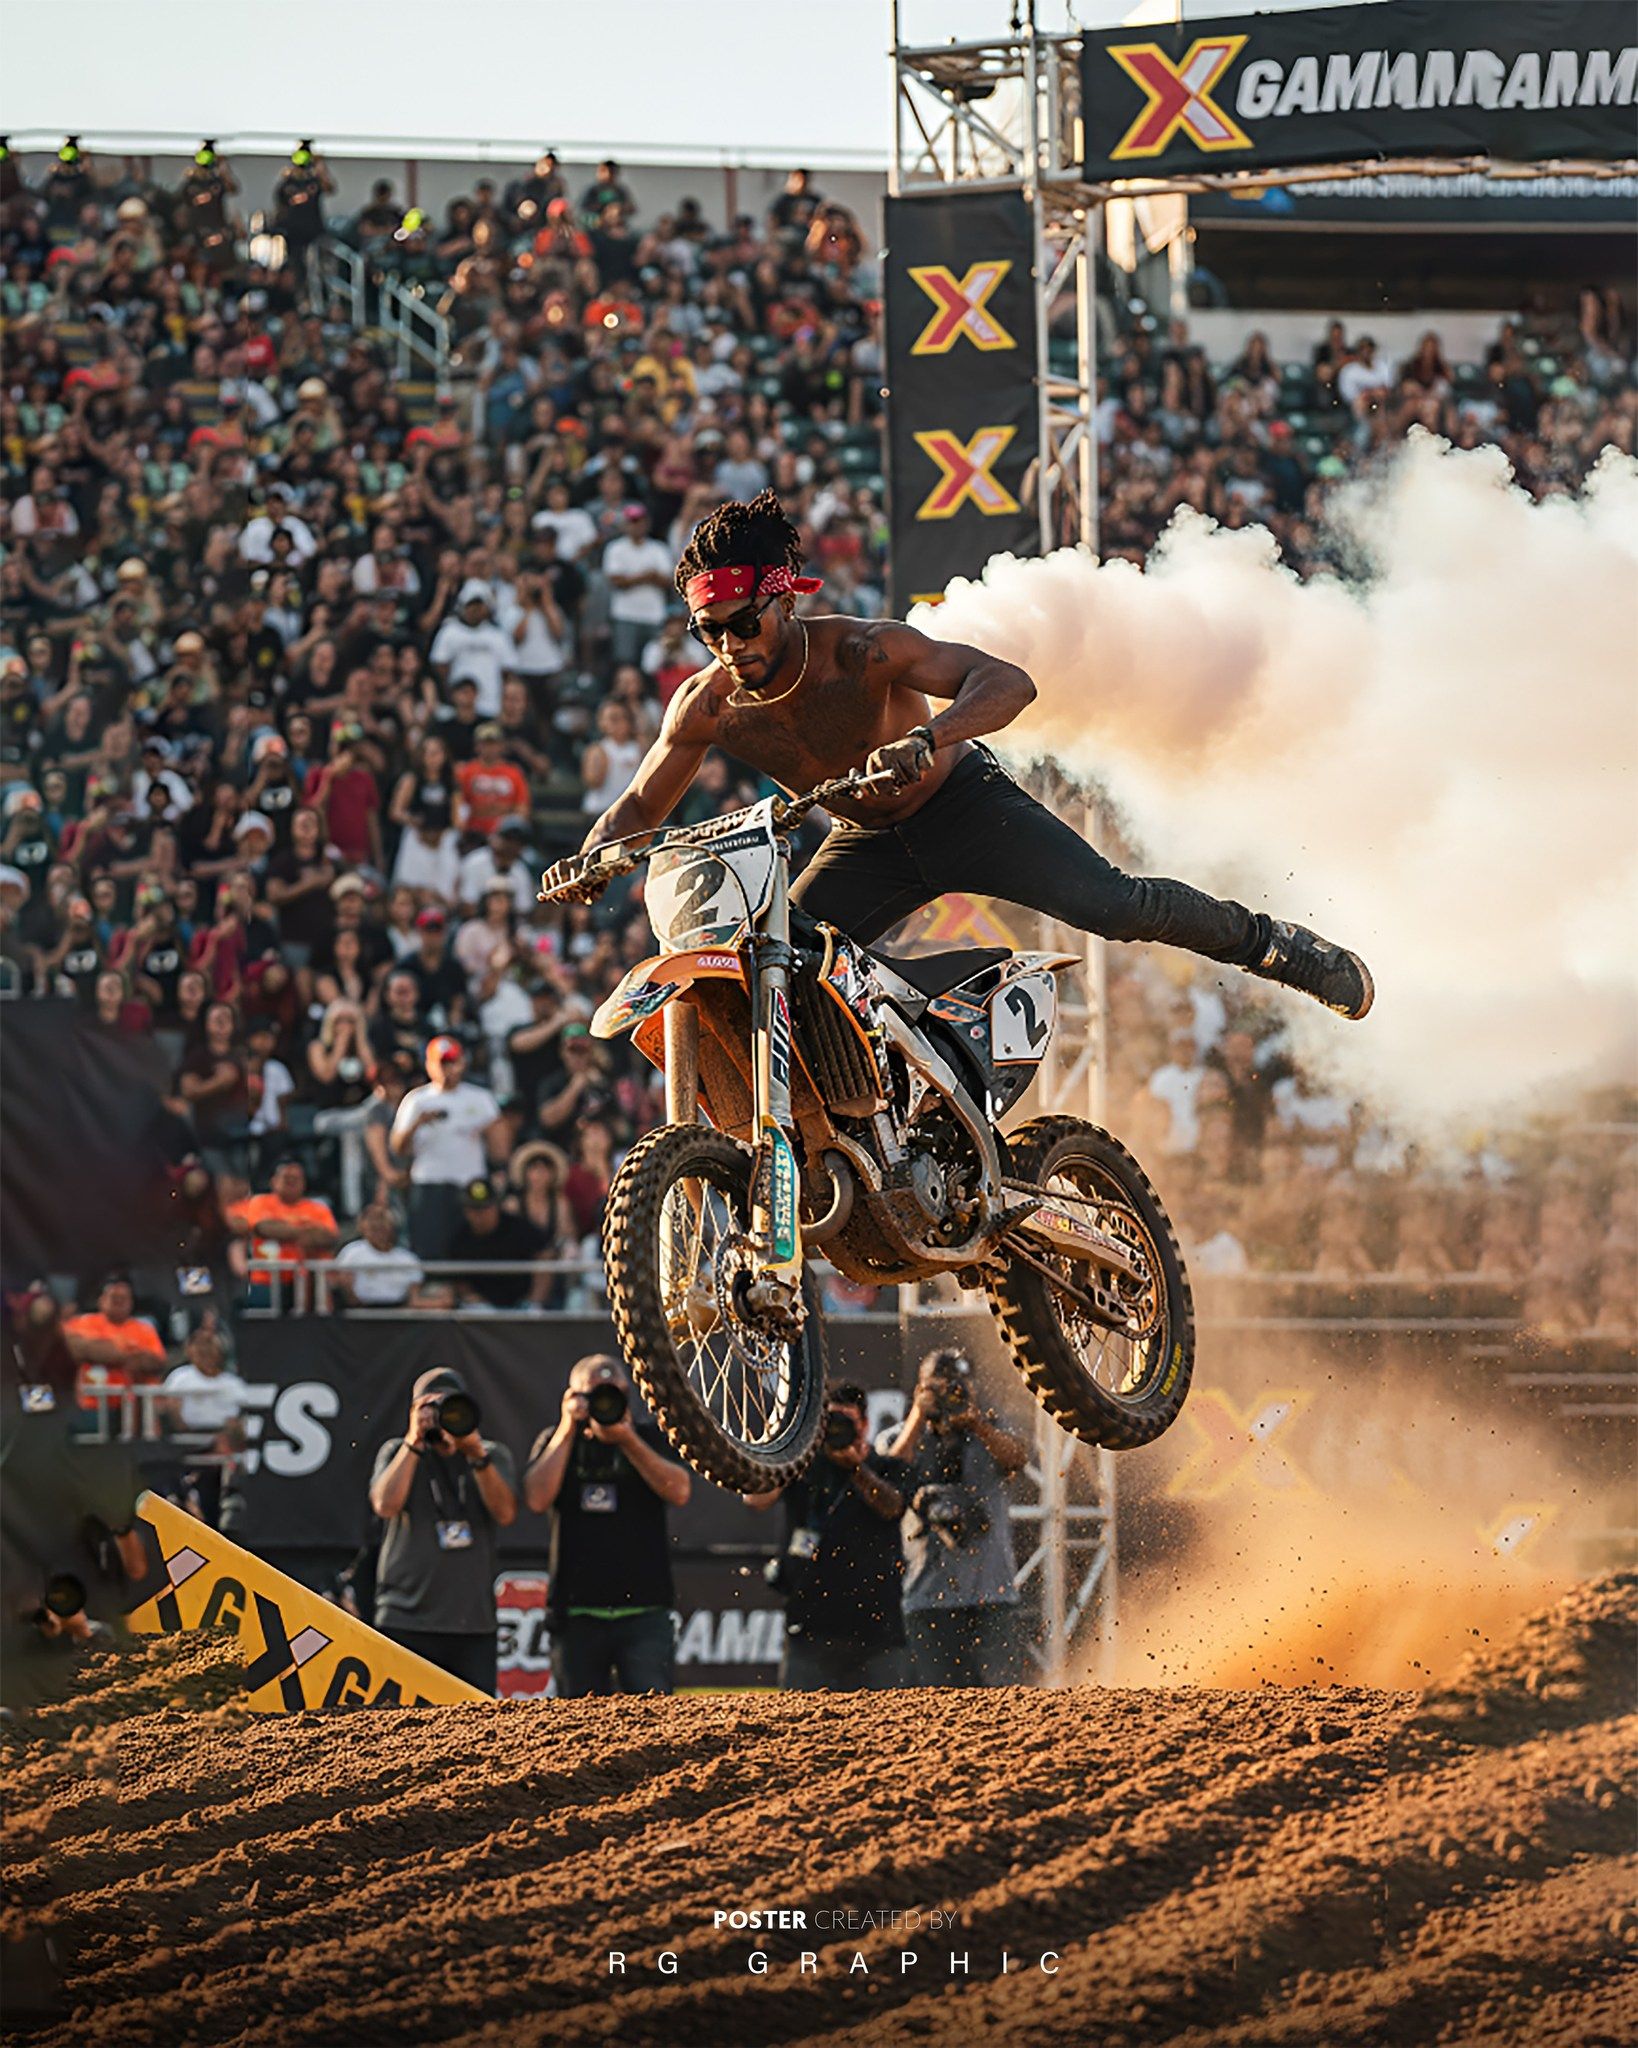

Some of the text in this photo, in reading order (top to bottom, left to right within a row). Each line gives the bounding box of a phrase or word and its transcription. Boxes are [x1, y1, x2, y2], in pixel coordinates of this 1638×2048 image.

[1106, 34, 1255, 160] X
[907, 260, 1018, 355] X
[913, 425, 1021, 520] X
[669, 859, 726, 942] 2
[1004, 985, 1048, 1050] 2
